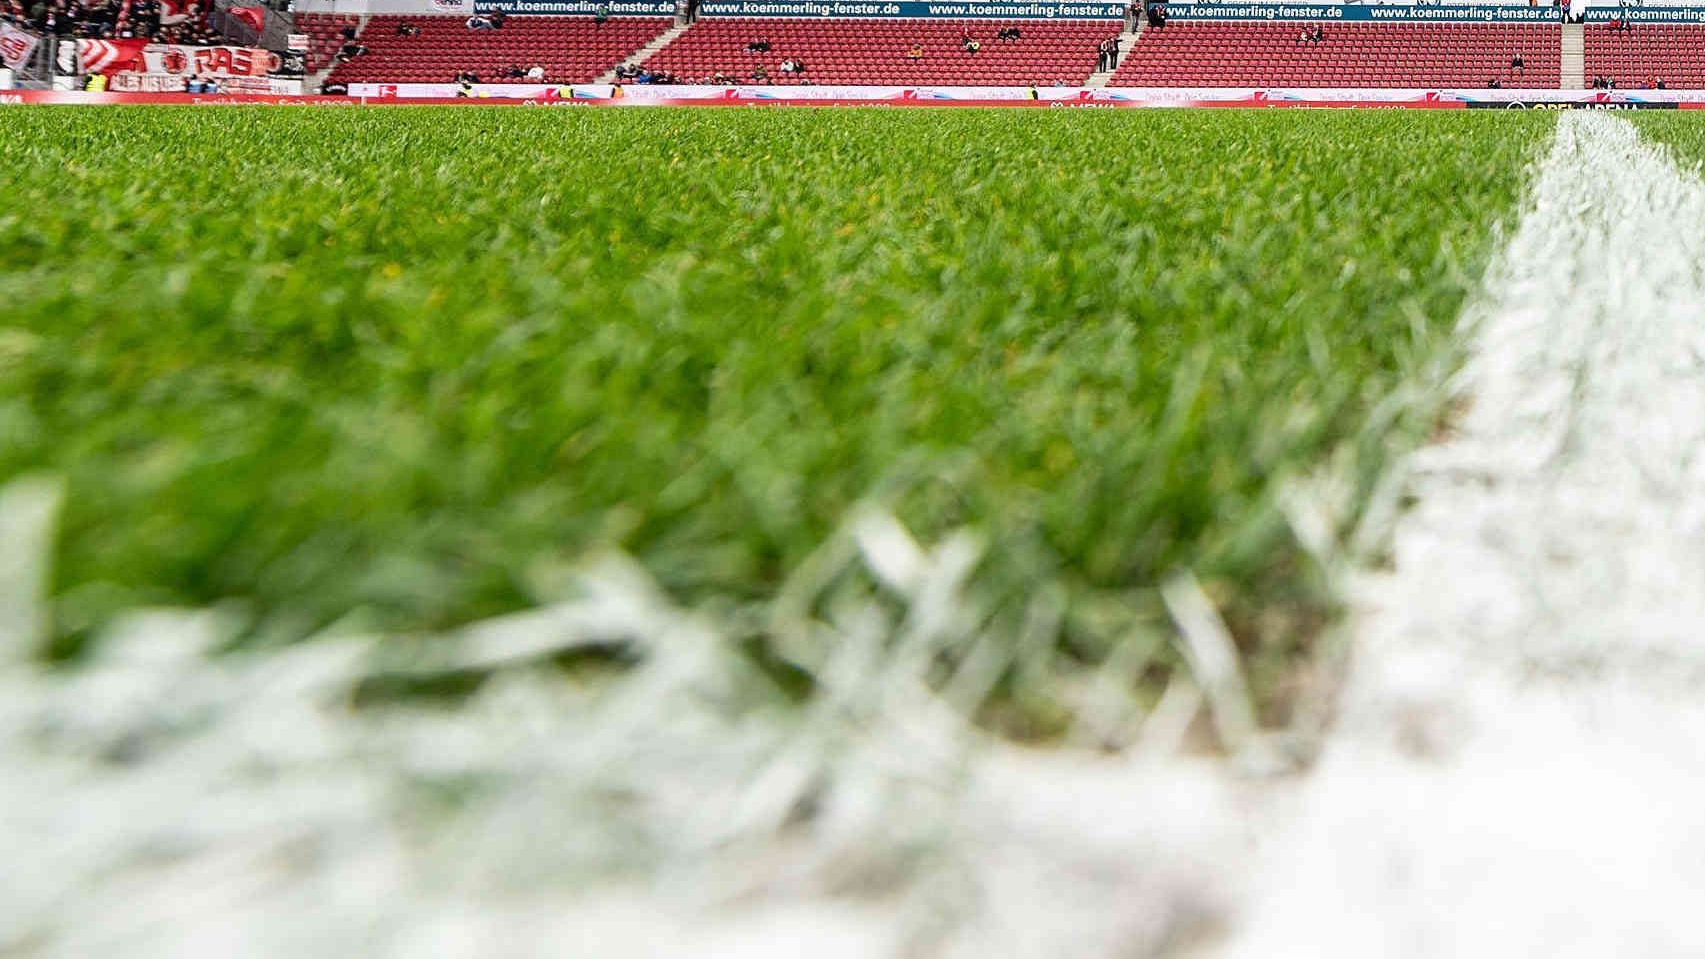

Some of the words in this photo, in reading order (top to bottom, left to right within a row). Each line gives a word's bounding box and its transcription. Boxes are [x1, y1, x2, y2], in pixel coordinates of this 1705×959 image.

[702, 1, 900, 16] www.koemmerling-fenster.de
[929, 4, 1124, 18] www.koemmerling-fenster.de
[1371, 7, 1560, 20] www.koemmerling-fenster.de
